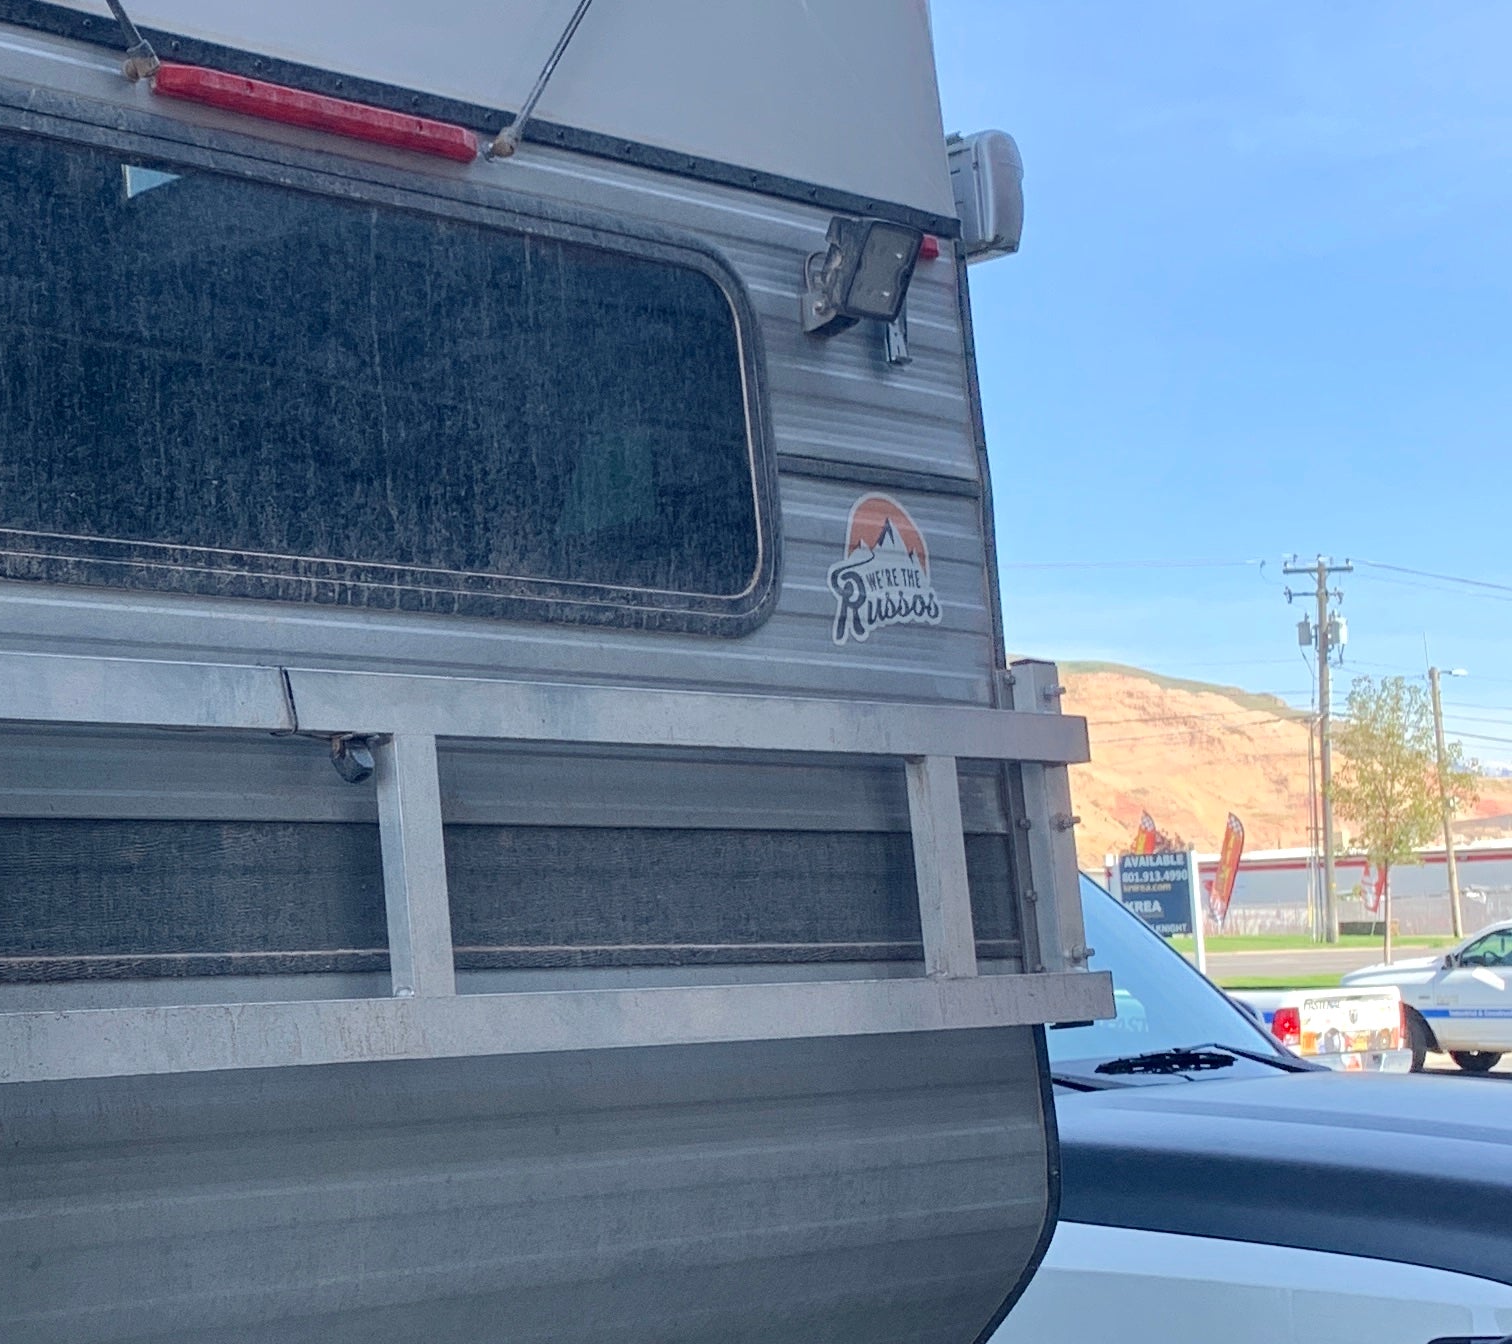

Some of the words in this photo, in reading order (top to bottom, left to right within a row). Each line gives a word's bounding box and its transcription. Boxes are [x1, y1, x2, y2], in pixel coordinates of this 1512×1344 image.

[865, 567, 899, 592] WE'RE
[900, 567, 922, 589] THE
[831, 570, 939, 640] Russos
[1124, 853, 1185, 868] AVAILABLE
